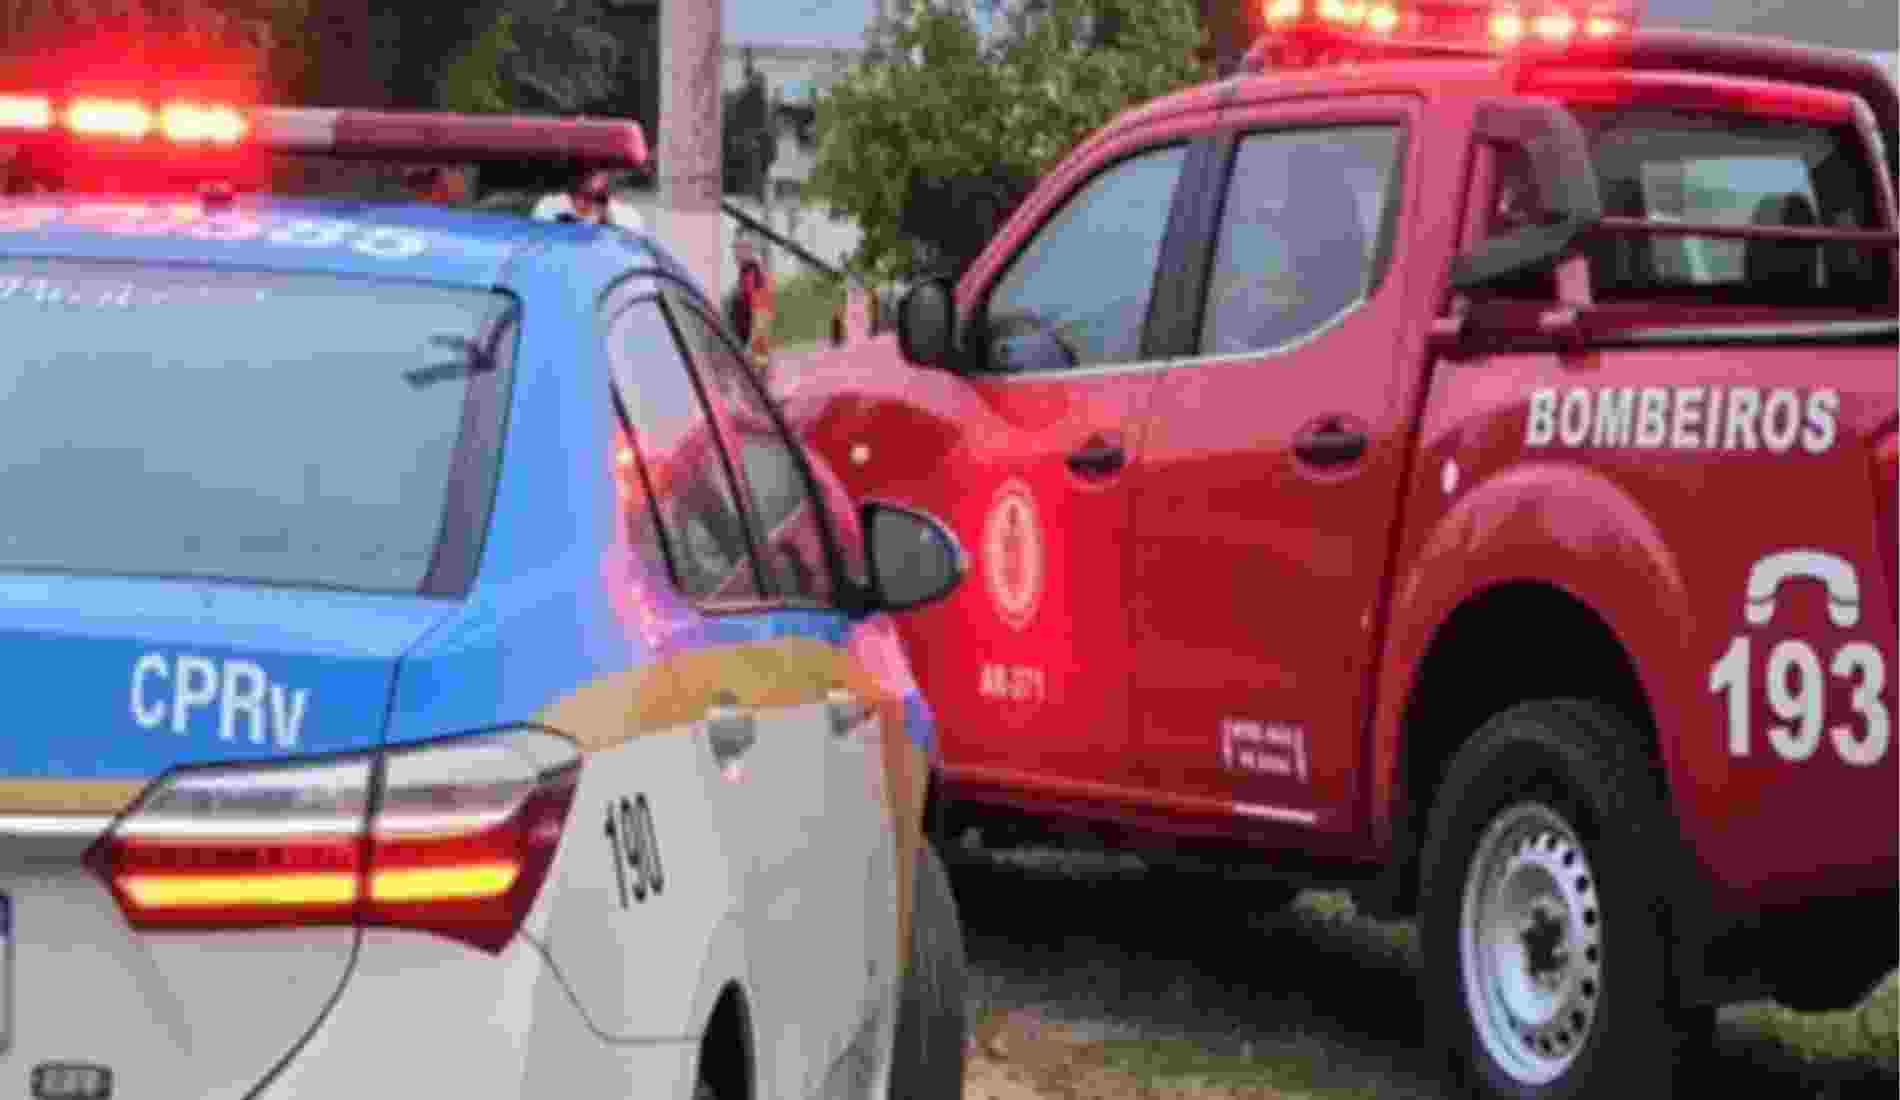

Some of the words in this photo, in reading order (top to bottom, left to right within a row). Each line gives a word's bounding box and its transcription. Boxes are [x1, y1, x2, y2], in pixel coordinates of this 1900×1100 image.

[1524, 386, 1839, 454] BOMBEIROS
[129, 652, 309, 749] CPRv
[1708, 637, 1889, 766] 193
[604, 793, 664, 911] 190
